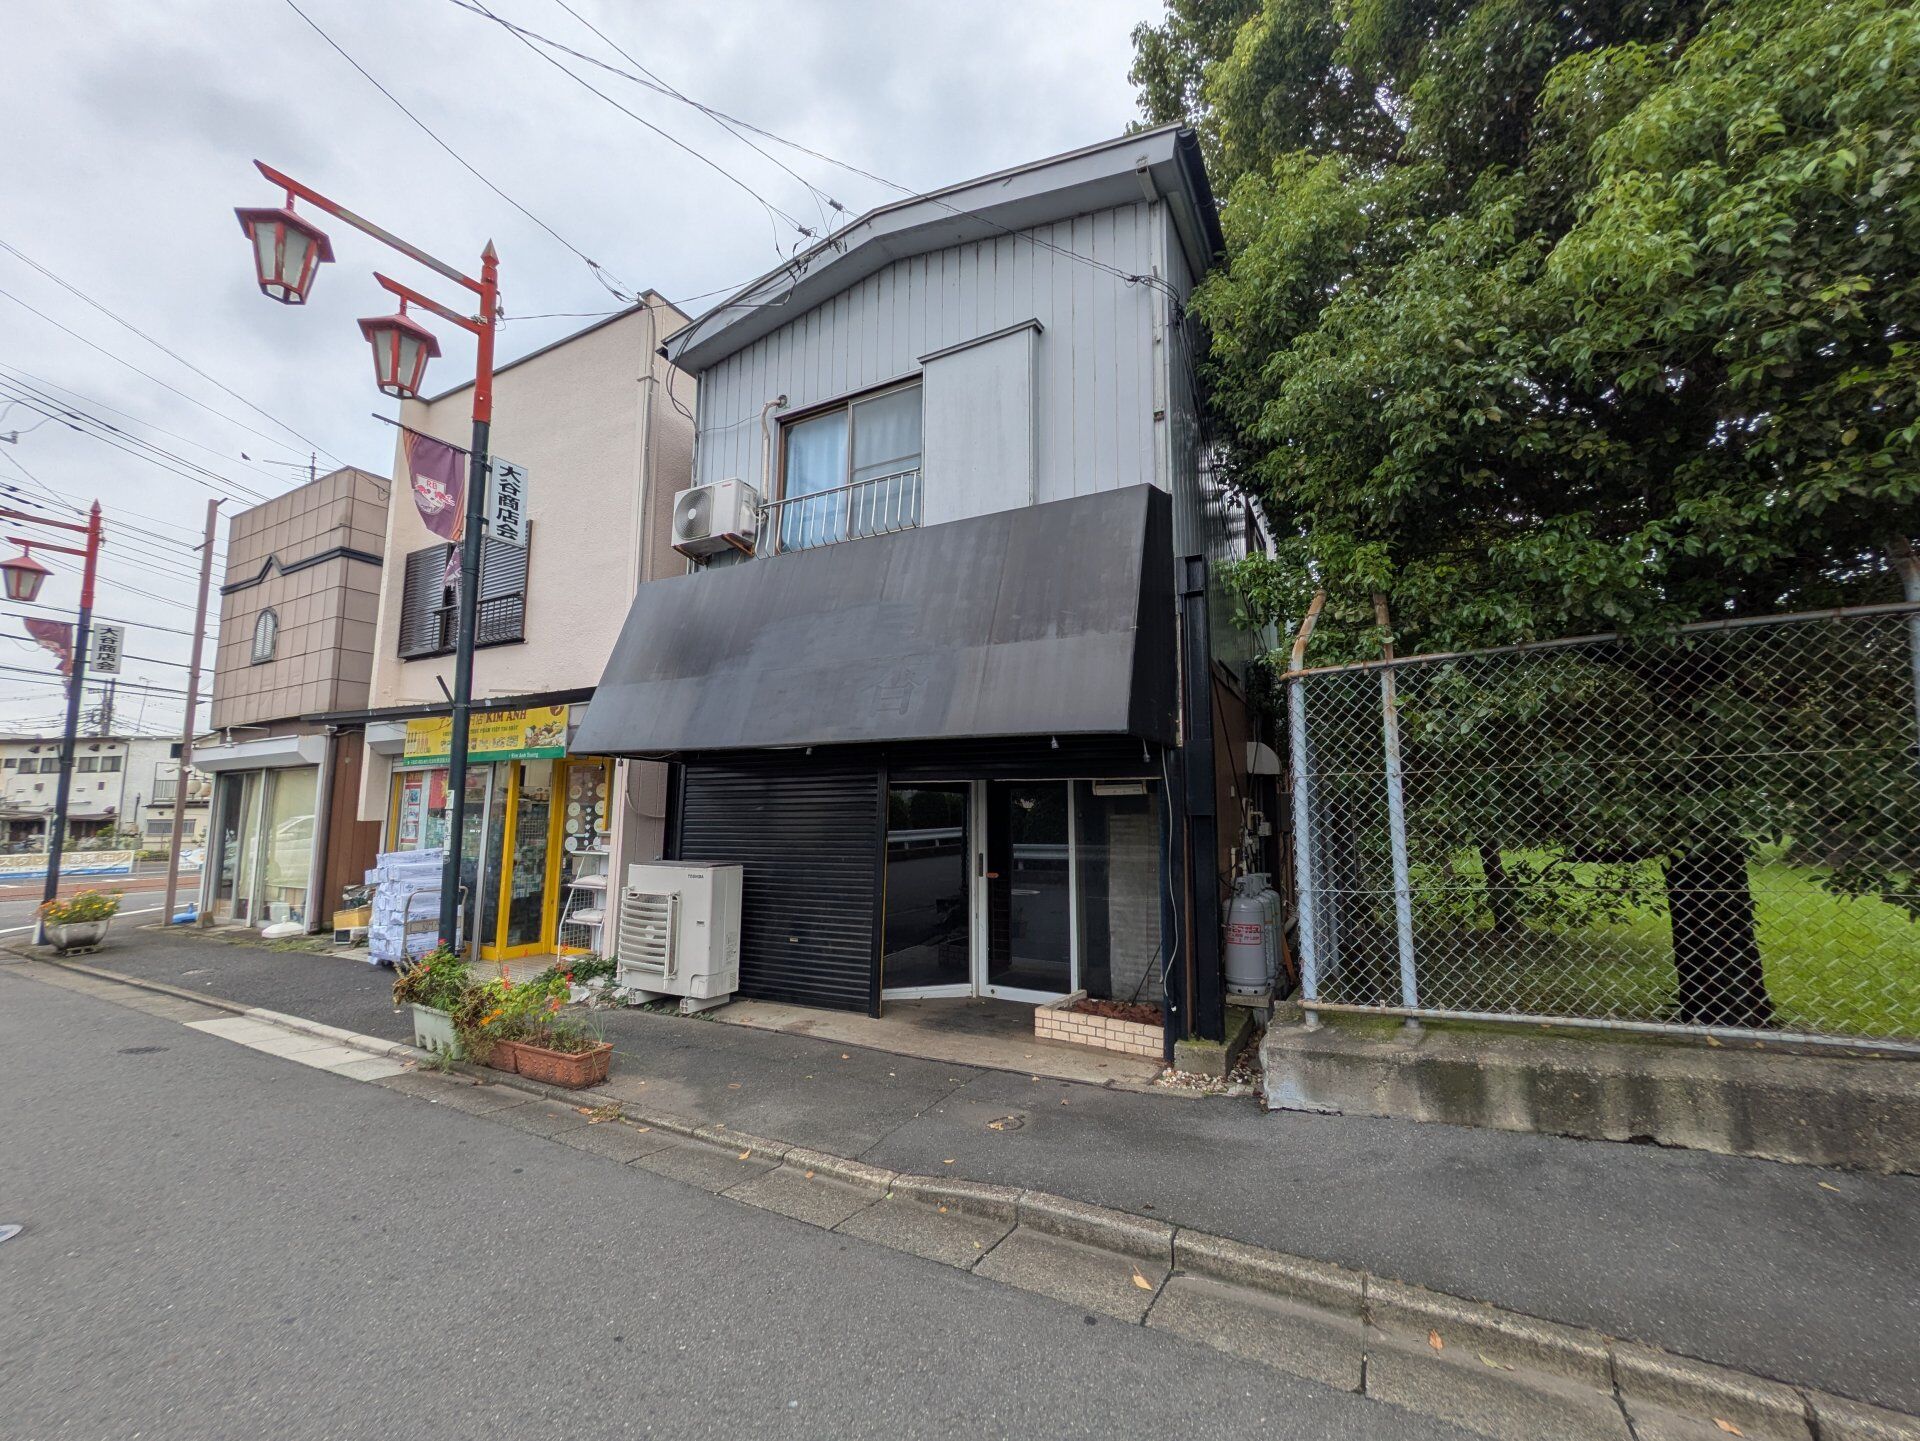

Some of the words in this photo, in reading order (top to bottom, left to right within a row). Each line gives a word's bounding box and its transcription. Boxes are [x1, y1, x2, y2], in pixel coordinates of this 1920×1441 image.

[496, 465, 522, 541] 大谷商店会
[96, 627, 119, 671] 大谷商店会
[485, 711, 504, 723] KIM
[506, 709, 526, 721] ANH
